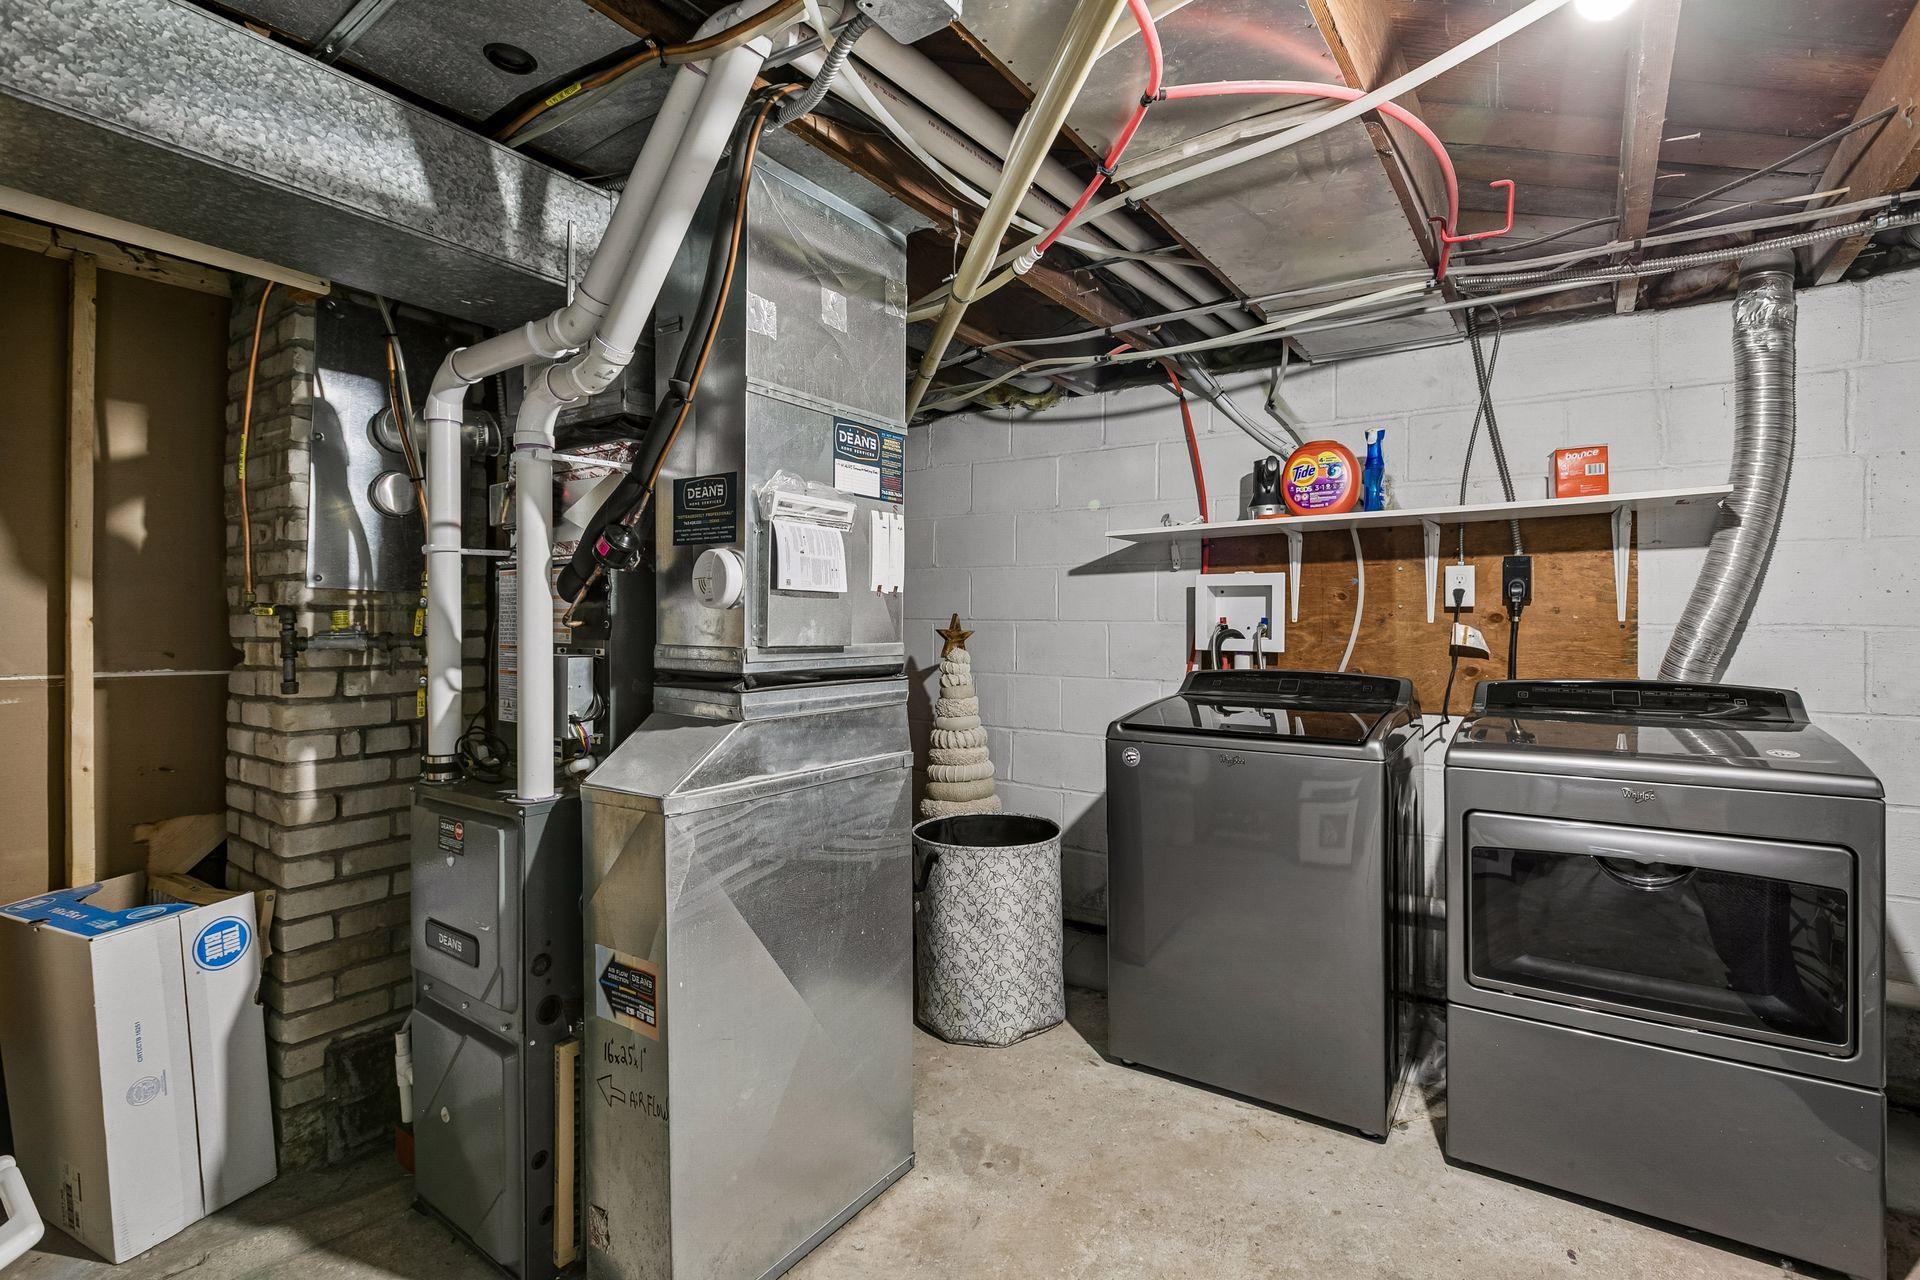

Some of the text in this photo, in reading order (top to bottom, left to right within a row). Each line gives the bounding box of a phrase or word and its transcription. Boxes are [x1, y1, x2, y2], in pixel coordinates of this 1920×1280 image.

[1565, 448, 1600, 460] bounce
[1293, 464, 1316, 482] Tide
[204, 931, 224, 963] BLUE
[222, 923, 241, 956] TRUE
